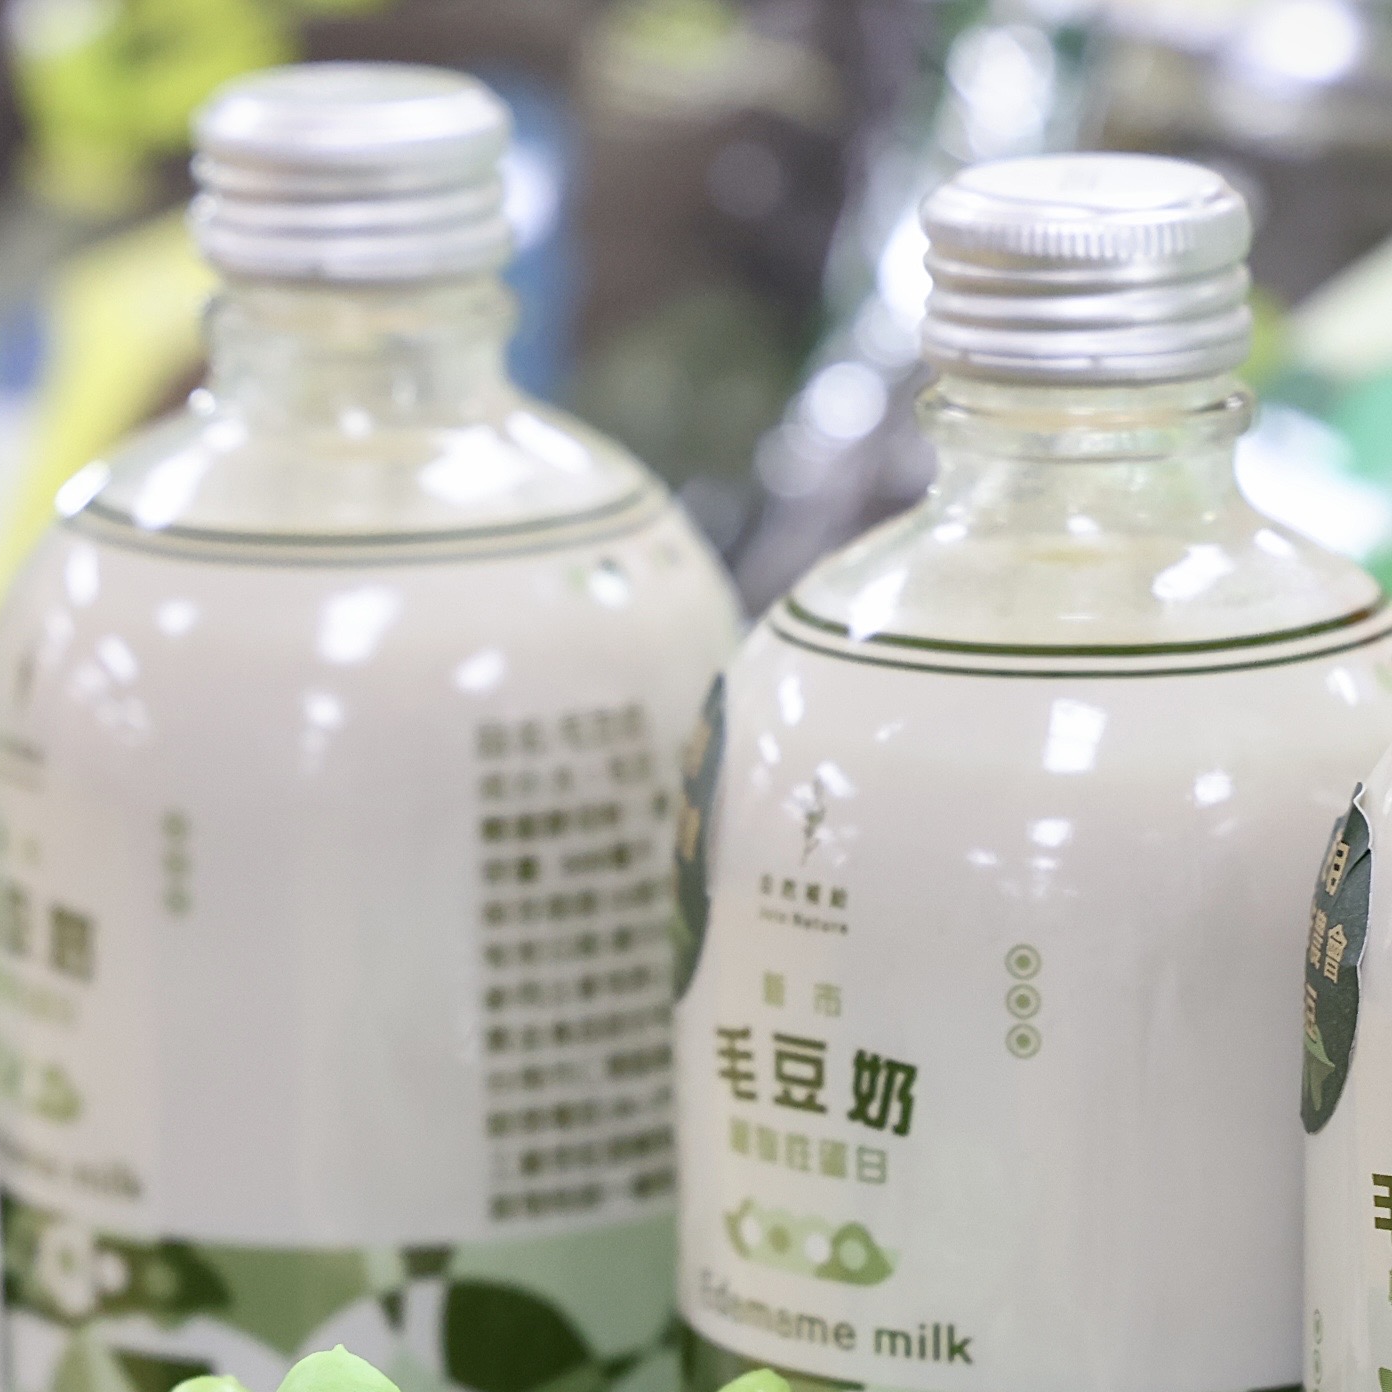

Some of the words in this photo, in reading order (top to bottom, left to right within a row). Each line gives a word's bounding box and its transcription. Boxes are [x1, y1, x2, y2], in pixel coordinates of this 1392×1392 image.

[715, 1026, 918, 1137] 毛豆奶
[874, 1321, 974, 1365] milk
